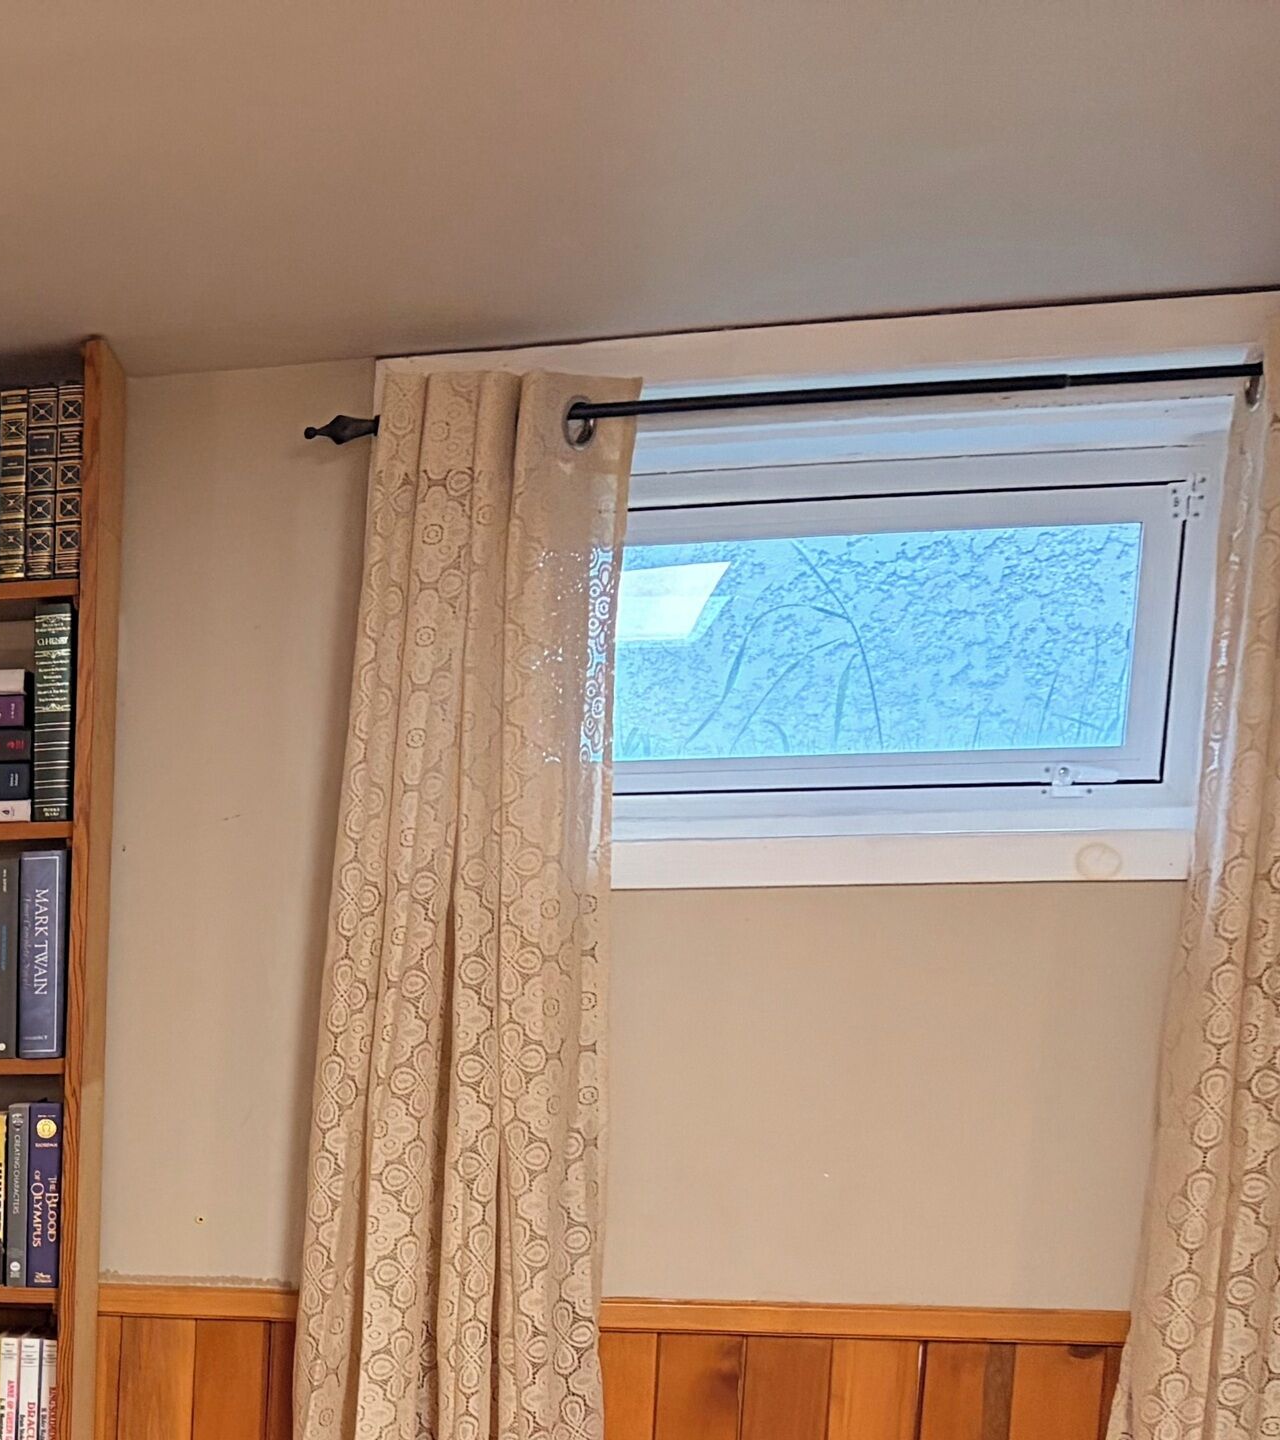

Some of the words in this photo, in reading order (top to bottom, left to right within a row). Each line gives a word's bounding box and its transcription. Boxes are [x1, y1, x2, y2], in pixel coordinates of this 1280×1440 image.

[34, 888, 49, 937] MARK
[33, 939, 49, 996] TWAIN
[48, 1175, 58, 1192] THE
[31, 1182, 44, 1248] OLYMPUS
[45, 1192, 59, 1242] BLOOD
